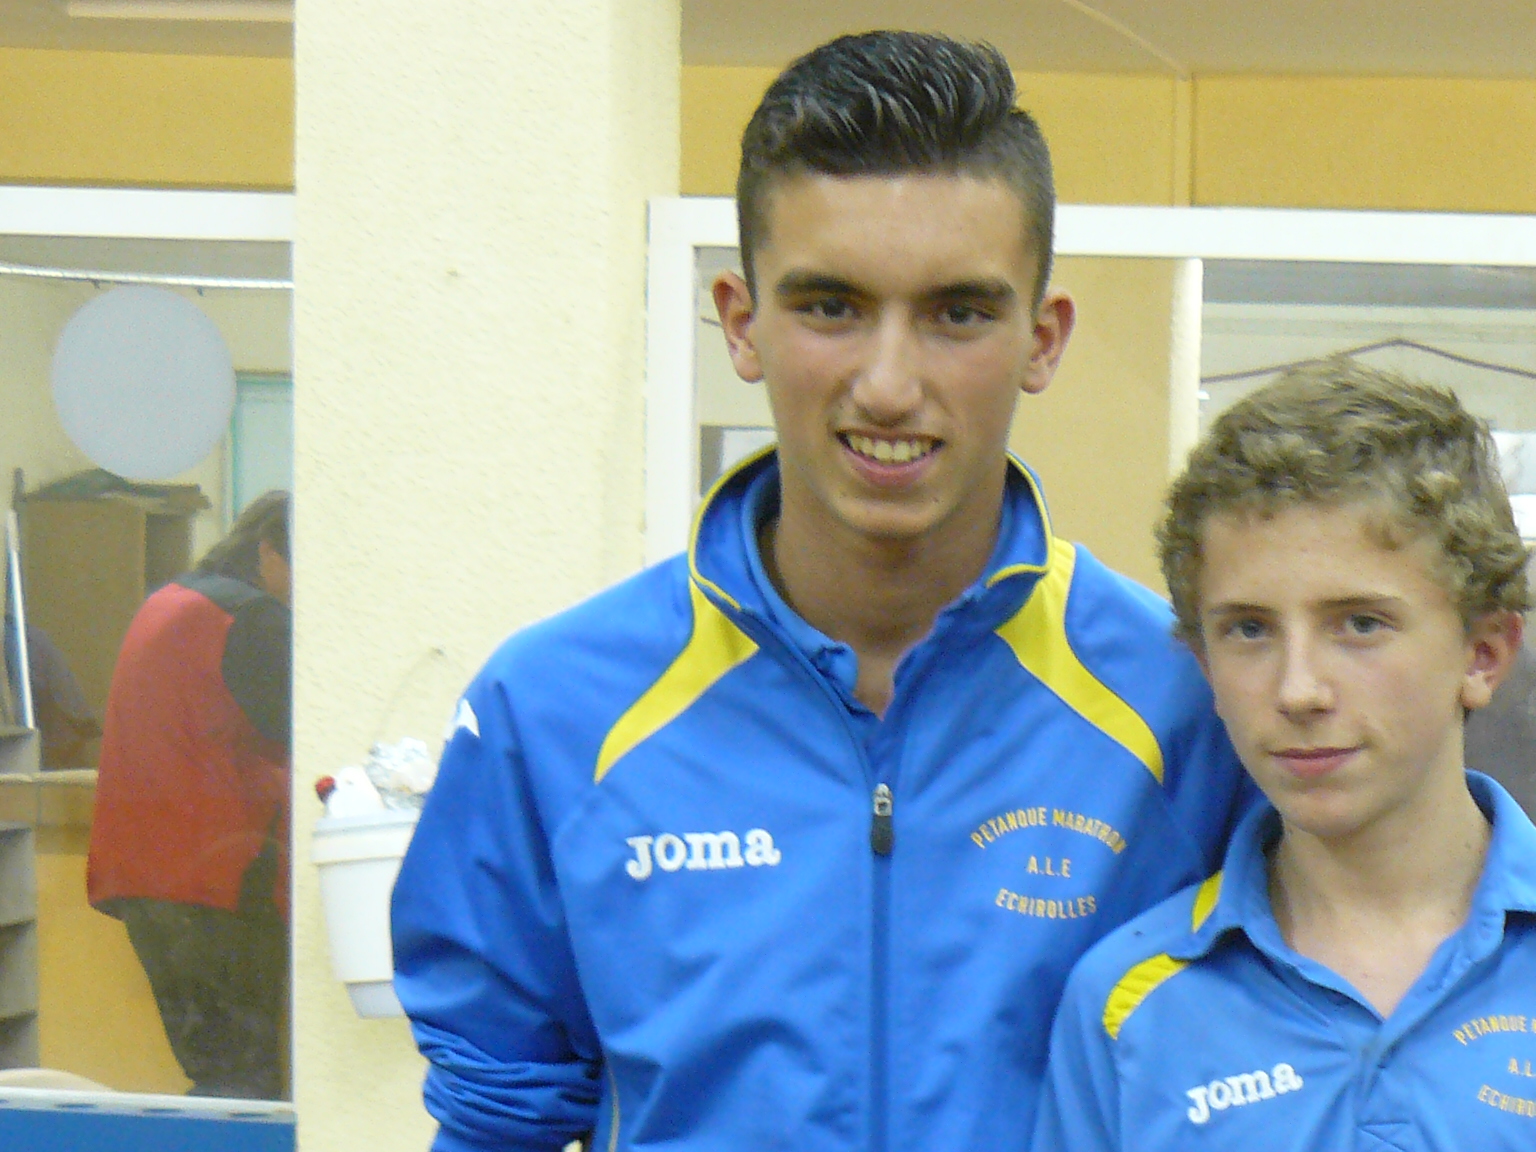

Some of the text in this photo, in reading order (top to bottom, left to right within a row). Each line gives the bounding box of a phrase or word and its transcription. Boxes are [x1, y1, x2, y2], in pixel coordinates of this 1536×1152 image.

[970, 807, 1127, 854] PETANQUE MARATHON
[995, 888, 1097, 919] ECHIROLLES
[1453, 1015, 1527, 1046] PETANQUE
